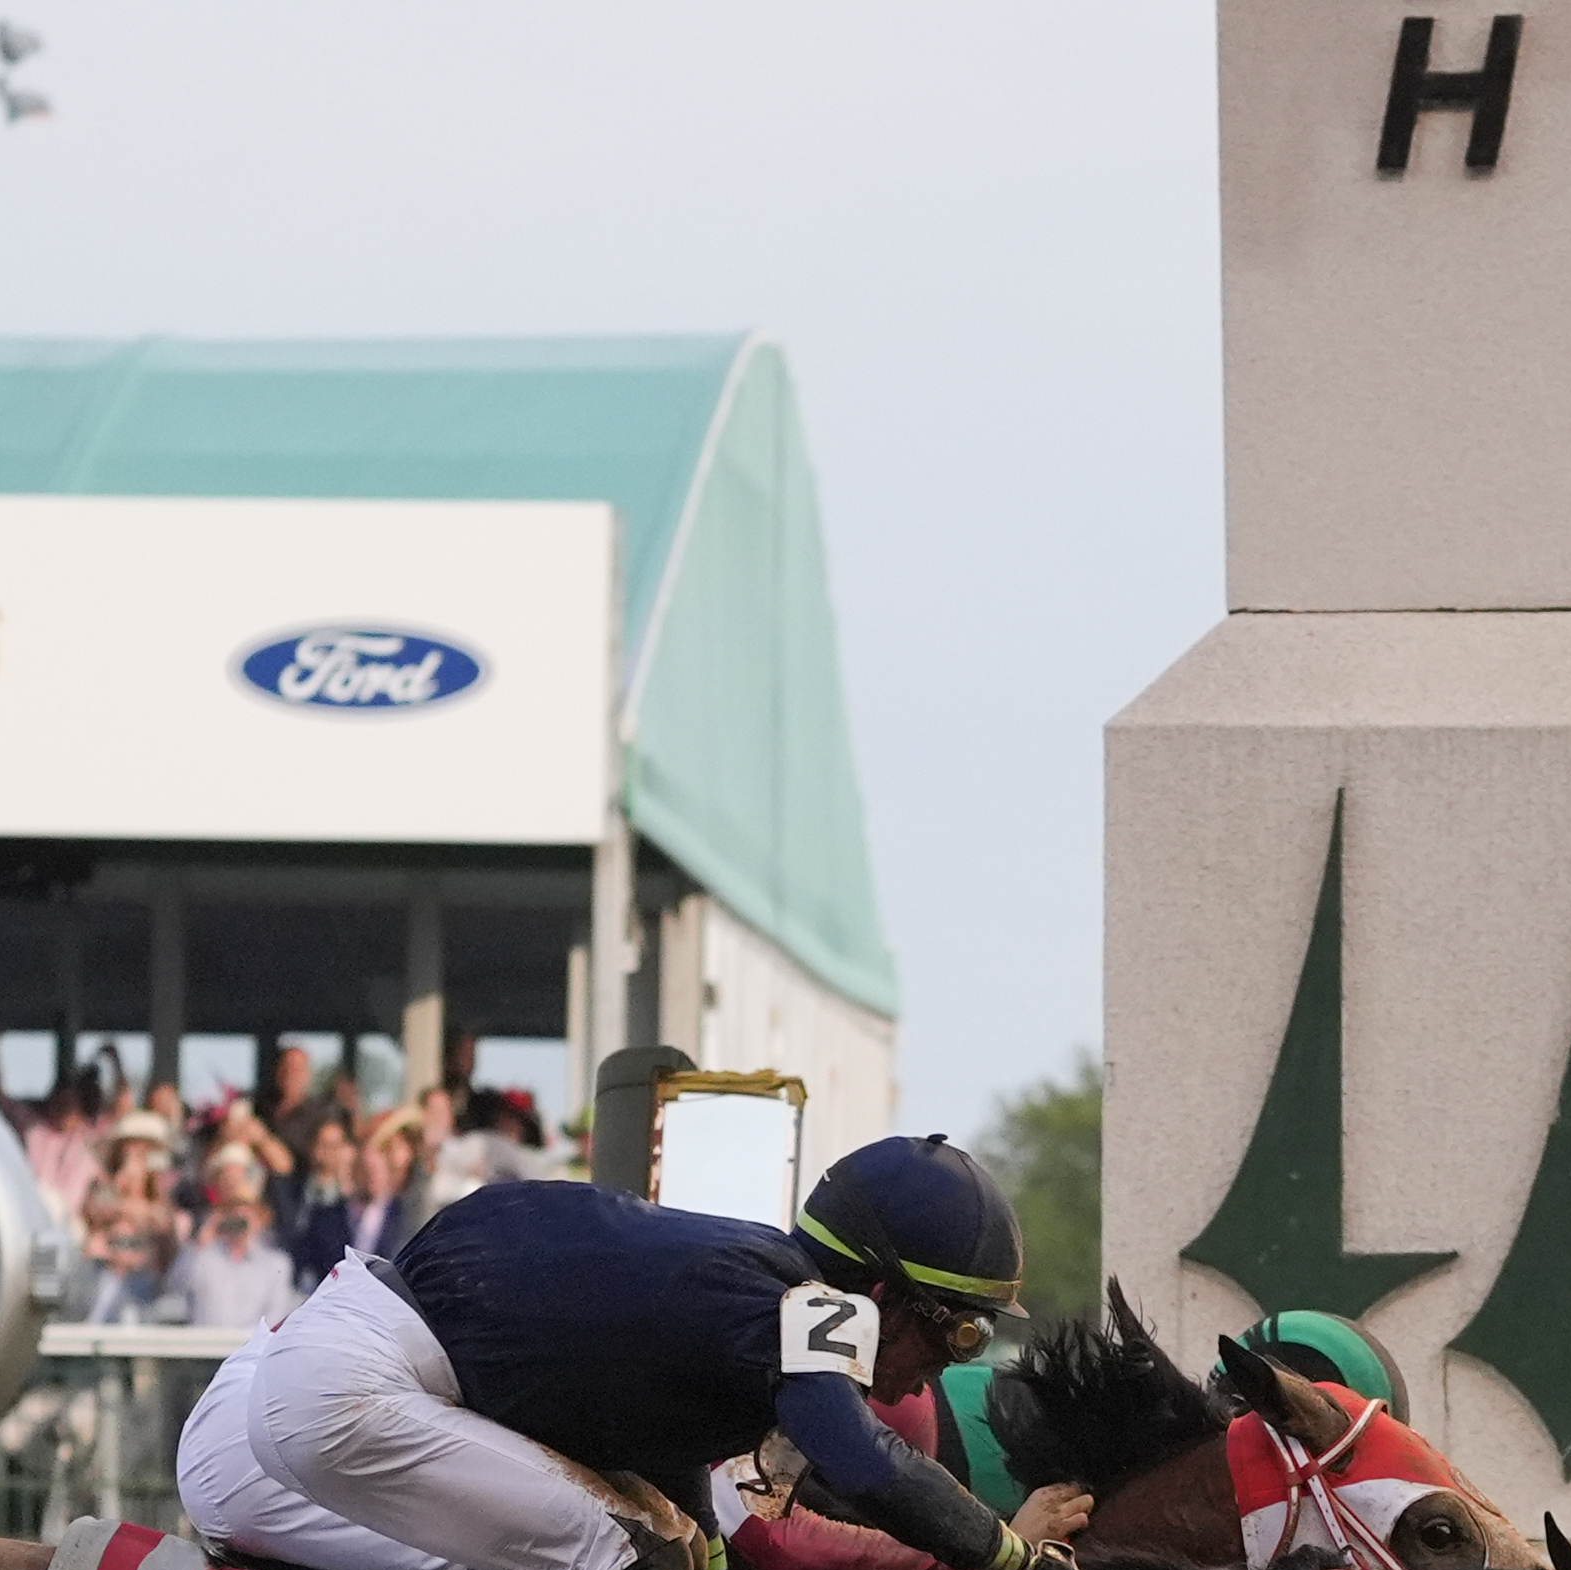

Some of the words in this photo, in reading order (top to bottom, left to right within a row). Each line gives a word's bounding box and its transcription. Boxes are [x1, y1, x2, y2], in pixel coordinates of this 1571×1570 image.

[1376, 14, 1525, 182] H
[277, 632, 444, 704] Ford
[807, 1297, 857, 1359] 2
